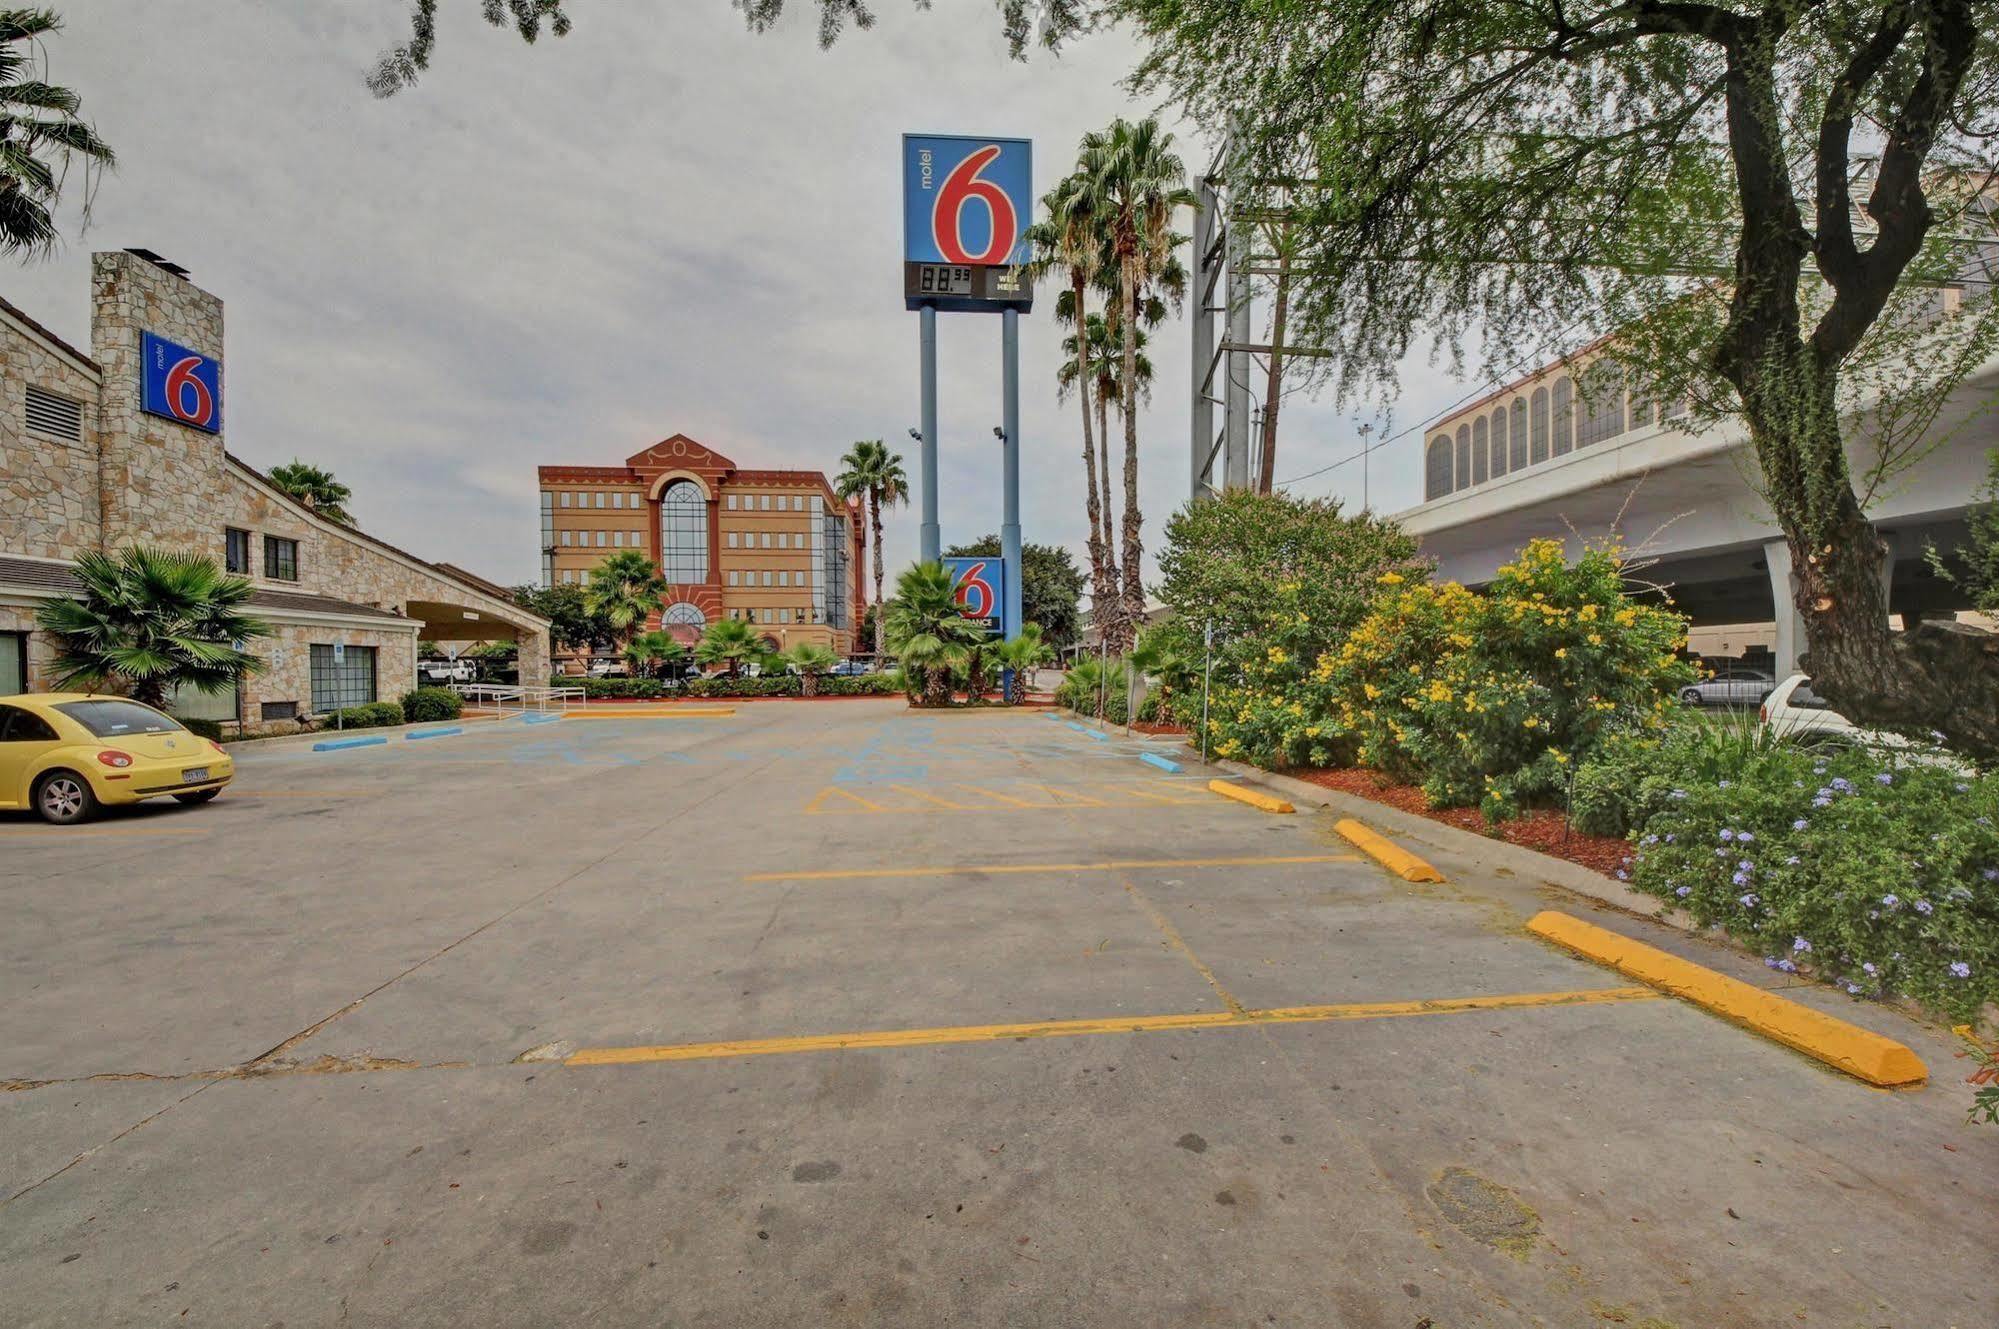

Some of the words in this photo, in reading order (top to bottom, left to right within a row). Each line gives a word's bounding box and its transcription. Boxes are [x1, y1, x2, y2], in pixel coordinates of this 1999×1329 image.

[919, 149, 932, 189] motel
[931, 144, 1018, 264] 6
[156, 344, 165, 370] motel
[165, 356, 213, 426] 6
[953, 562, 995, 618] 6
